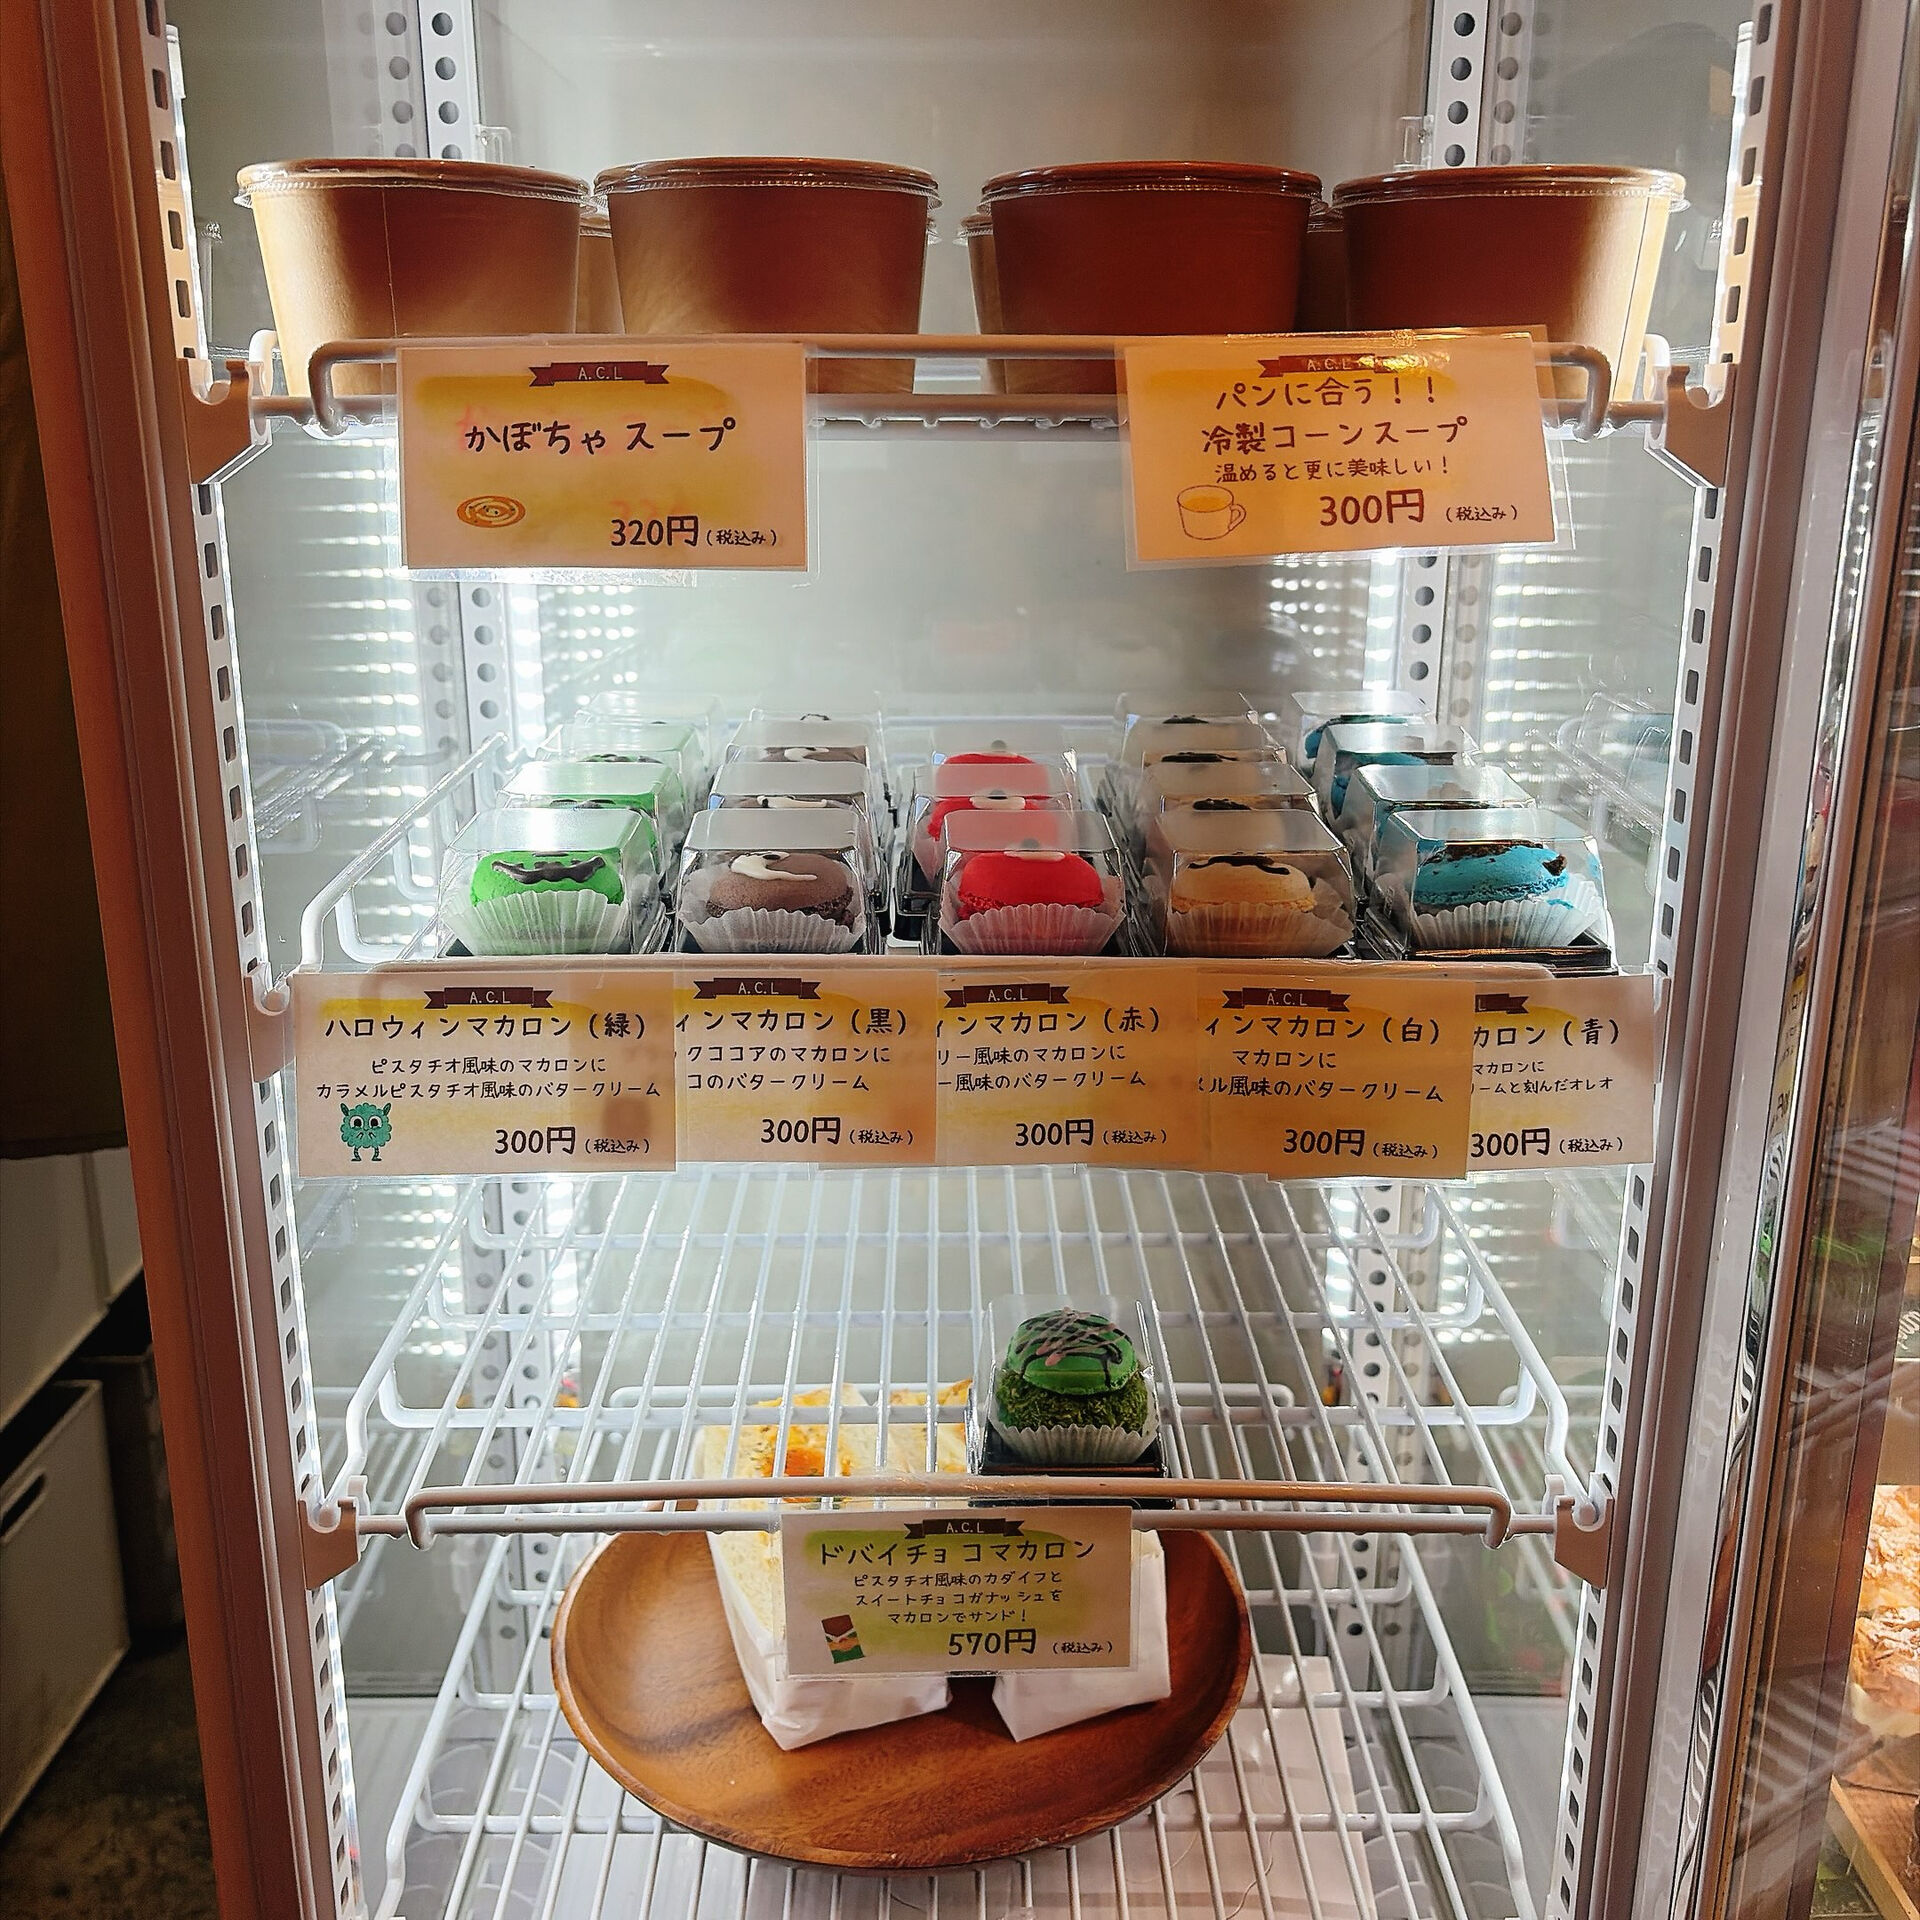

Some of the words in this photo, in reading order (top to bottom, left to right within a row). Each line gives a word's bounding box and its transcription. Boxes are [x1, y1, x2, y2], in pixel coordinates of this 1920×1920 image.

[577, 365, 625, 382] A.C.L
[1215, 376, 1435, 410] パンに合う！！
[1201, 415, 1468, 456] 冷製コーンスープ
[1214, 455, 1448, 484] 温めると更に美味しい！
[1319, 488, 1425, 527] 300円
[1445, 504, 1518, 523] （税込み）
[610, 515, 699, 547] 320円
[706, 528, 777, 547] （税込み）
[468, 990, 511, 1004] A.C.L
[737, 980, 780, 995] A.C.L
[986, 988, 1029, 1002] A.C.L
[1265, 992, 1308, 1006] A.C.L
[325, 1012, 645, 1040] ハロウィンマカロン（緑）
[371, 1056, 606, 1075] ピスタチオ風味のマカロンに
[938, 1045, 1126, 1066] リー風味のマカロンに
[1232, 1048, 1337, 1069] マカロンに
[1473, 1060, 1545, 1076] マカロンに
[316, 1080, 661, 1100] カラメルピスタチオ風味のバタークリーム
[687, 1072, 870, 1092] コのバタークリーム
[494, 1126, 576, 1155] 300円
[584, 1138, 650, 1155] （税込み）
[760, 1116, 841, 1145] 300円
[849, 1128, 914, 1146] （税込み）
[1015, 1118, 1094, 1147] 300円
[1102, 1129, 1167, 1145] （税込み）
[1283, 1128, 1365, 1157] 300円
[1372, 1142, 1438, 1159] （税込み）
[1470, 1127, 1551, 1158] 300円
[1559, 1136, 1623, 1155] （税込み）
[945, 1521, 985, 1535] A.C.L
[821, 1540, 1094, 1567] ドバイチョコマカロン
[854, 1570, 1062, 1588] ピスタチオ風味のカダイフと
[856, 1589, 1063, 1607] スイートチョコガナッシュを
[887, 1609, 1026, 1624] マカロンでサンド！
[948, 1628, 1037, 1656] 570円
